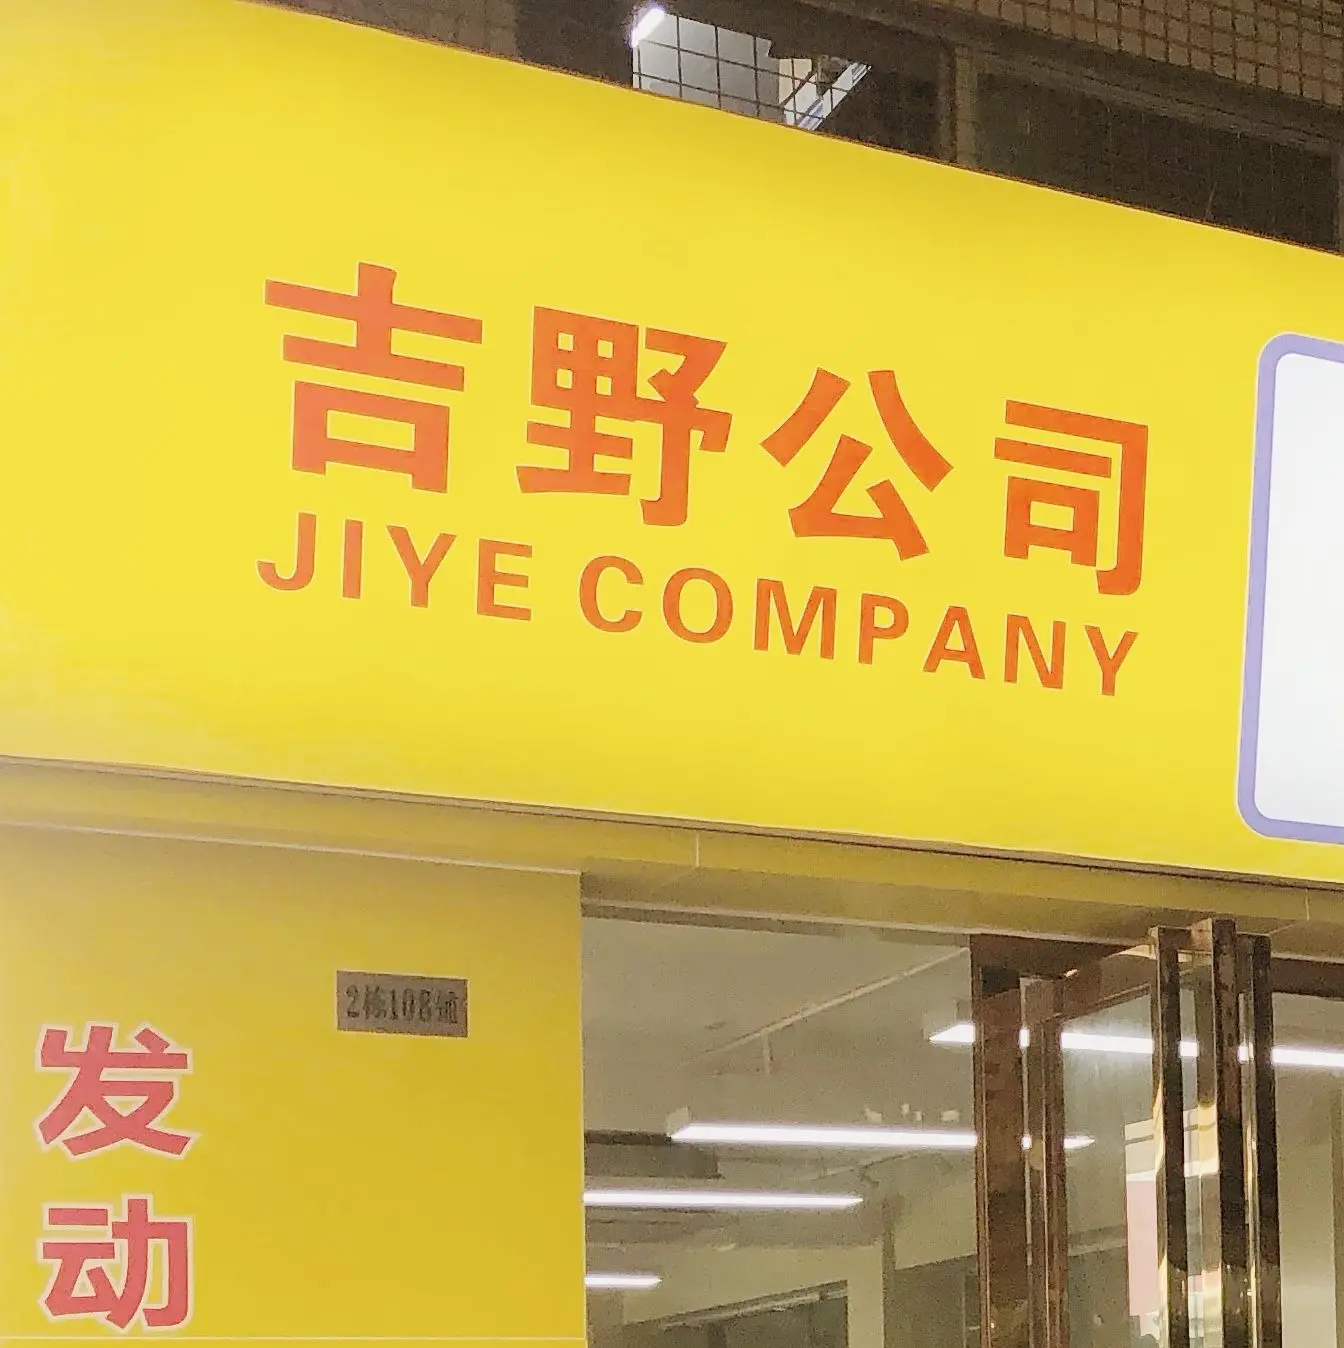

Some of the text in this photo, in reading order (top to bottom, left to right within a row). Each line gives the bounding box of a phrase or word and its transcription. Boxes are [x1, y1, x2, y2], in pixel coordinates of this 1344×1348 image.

[264, 262, 1149, 596] 吉野公司
[257, 512, 1140, 698] JIYE COMPANY
